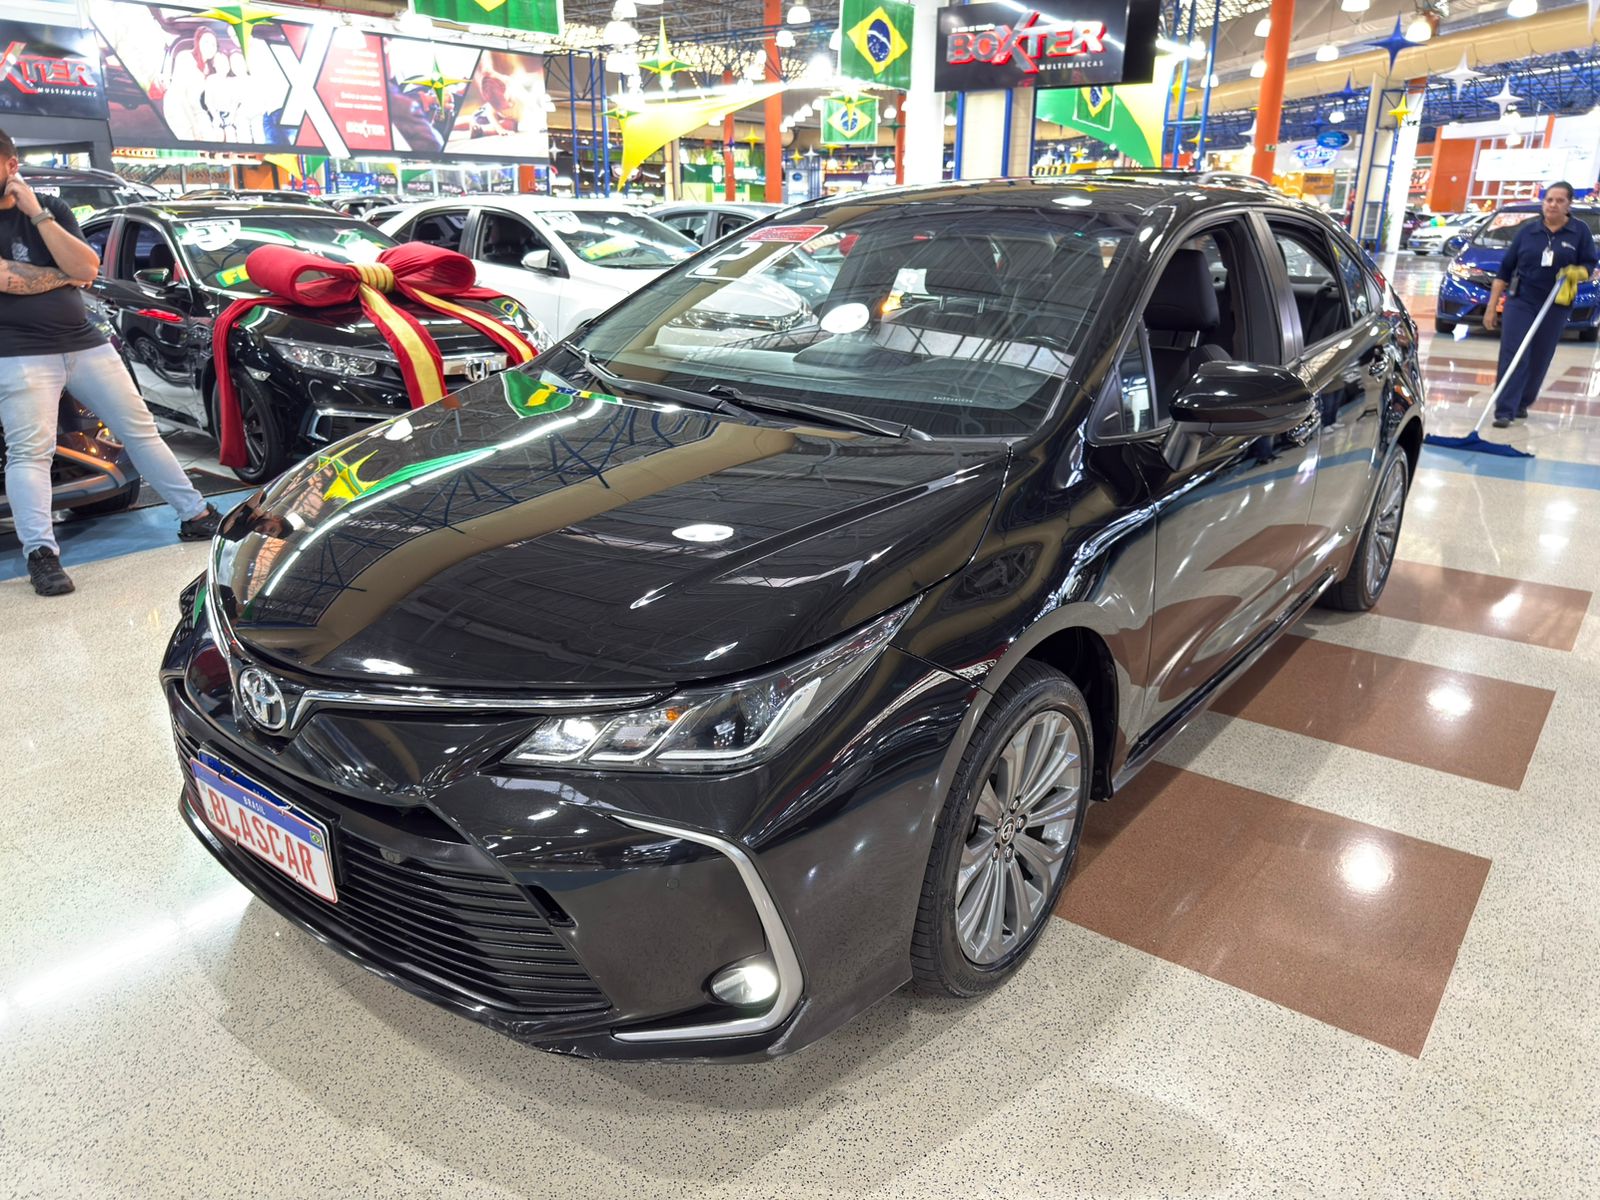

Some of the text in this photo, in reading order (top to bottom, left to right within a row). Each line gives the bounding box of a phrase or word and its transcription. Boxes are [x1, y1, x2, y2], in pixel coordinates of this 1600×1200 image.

[946, 9, 1107, 74] BOXTER
[1039, 60, 1104, 71] MULTIMARCAS
[37, 87, 97, 97] MULTIMARCAS
[242, 795, 266, 815] BRASIL
[208, 788, 318, 886] BLASCAR
